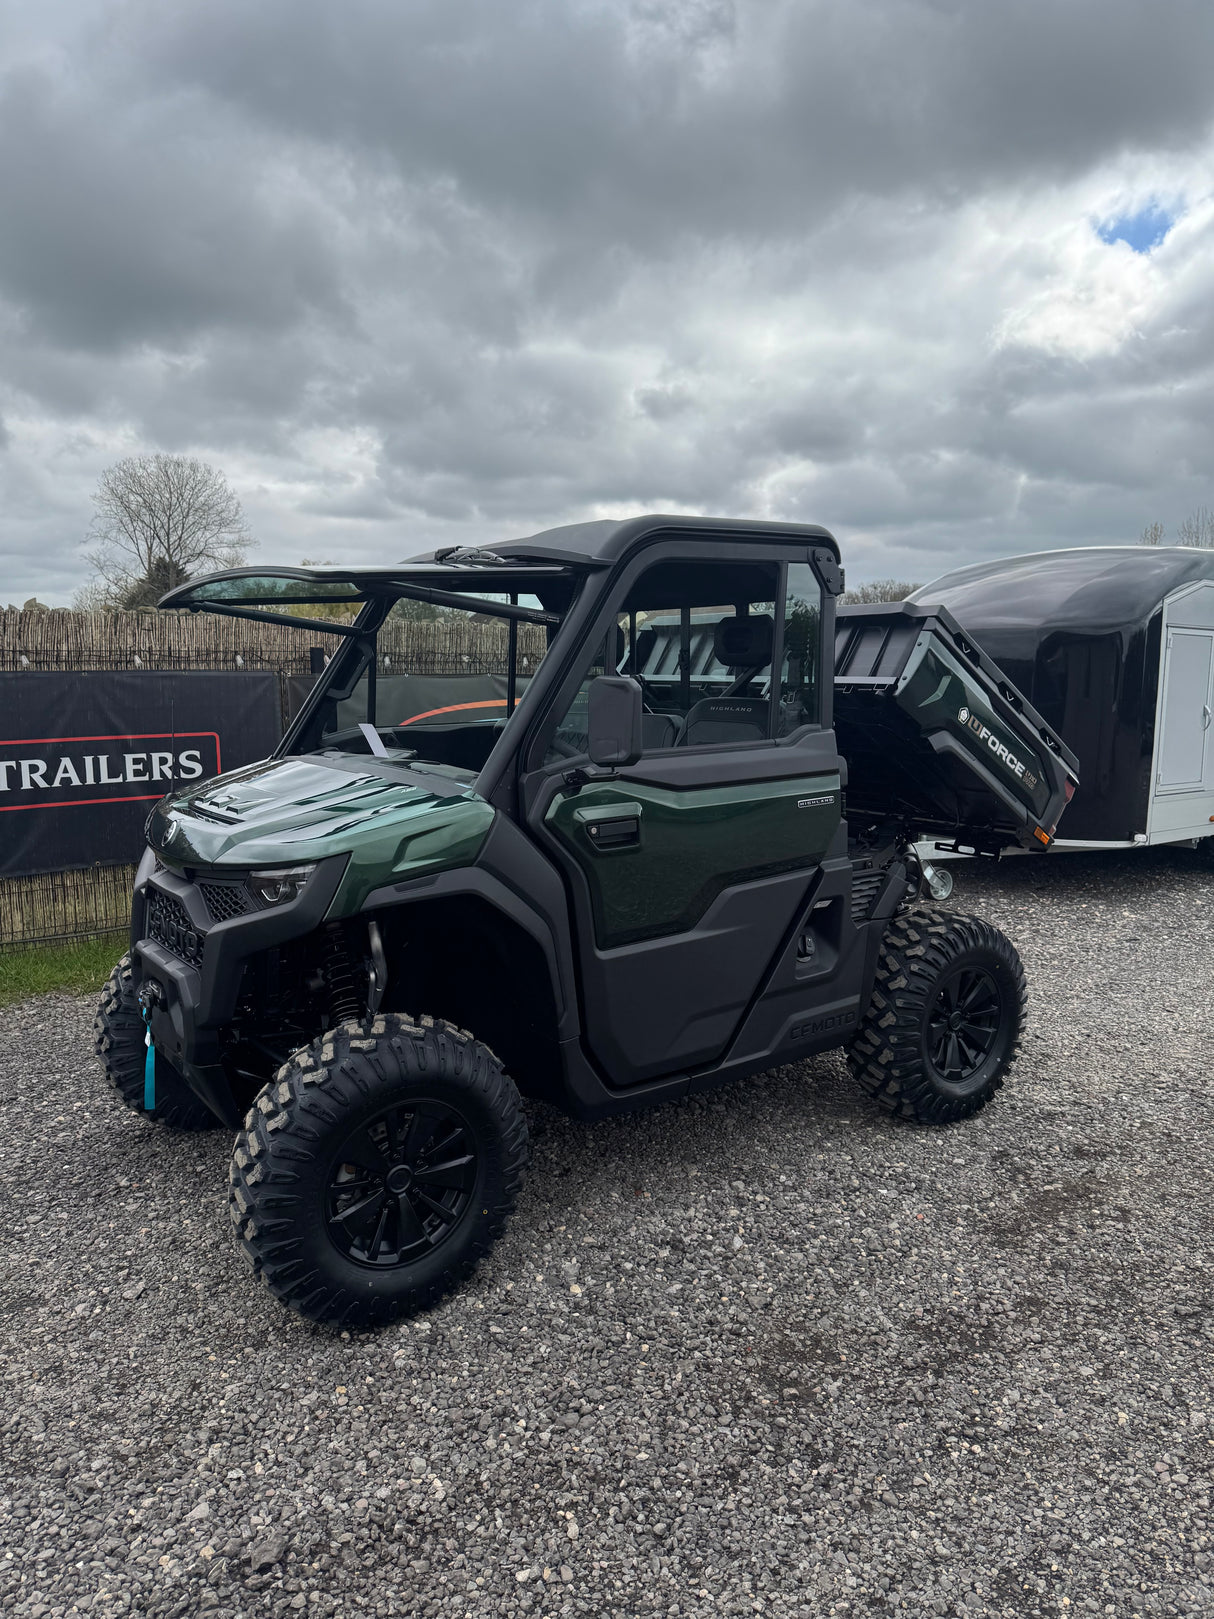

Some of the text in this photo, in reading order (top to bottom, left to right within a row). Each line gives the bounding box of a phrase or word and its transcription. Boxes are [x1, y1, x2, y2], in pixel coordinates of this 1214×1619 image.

[967, 715, 1026, 778] UFORCE
[0, 750, 203, 791] TRAILERS
[799, 797, 834, 806] HIGHLAND
